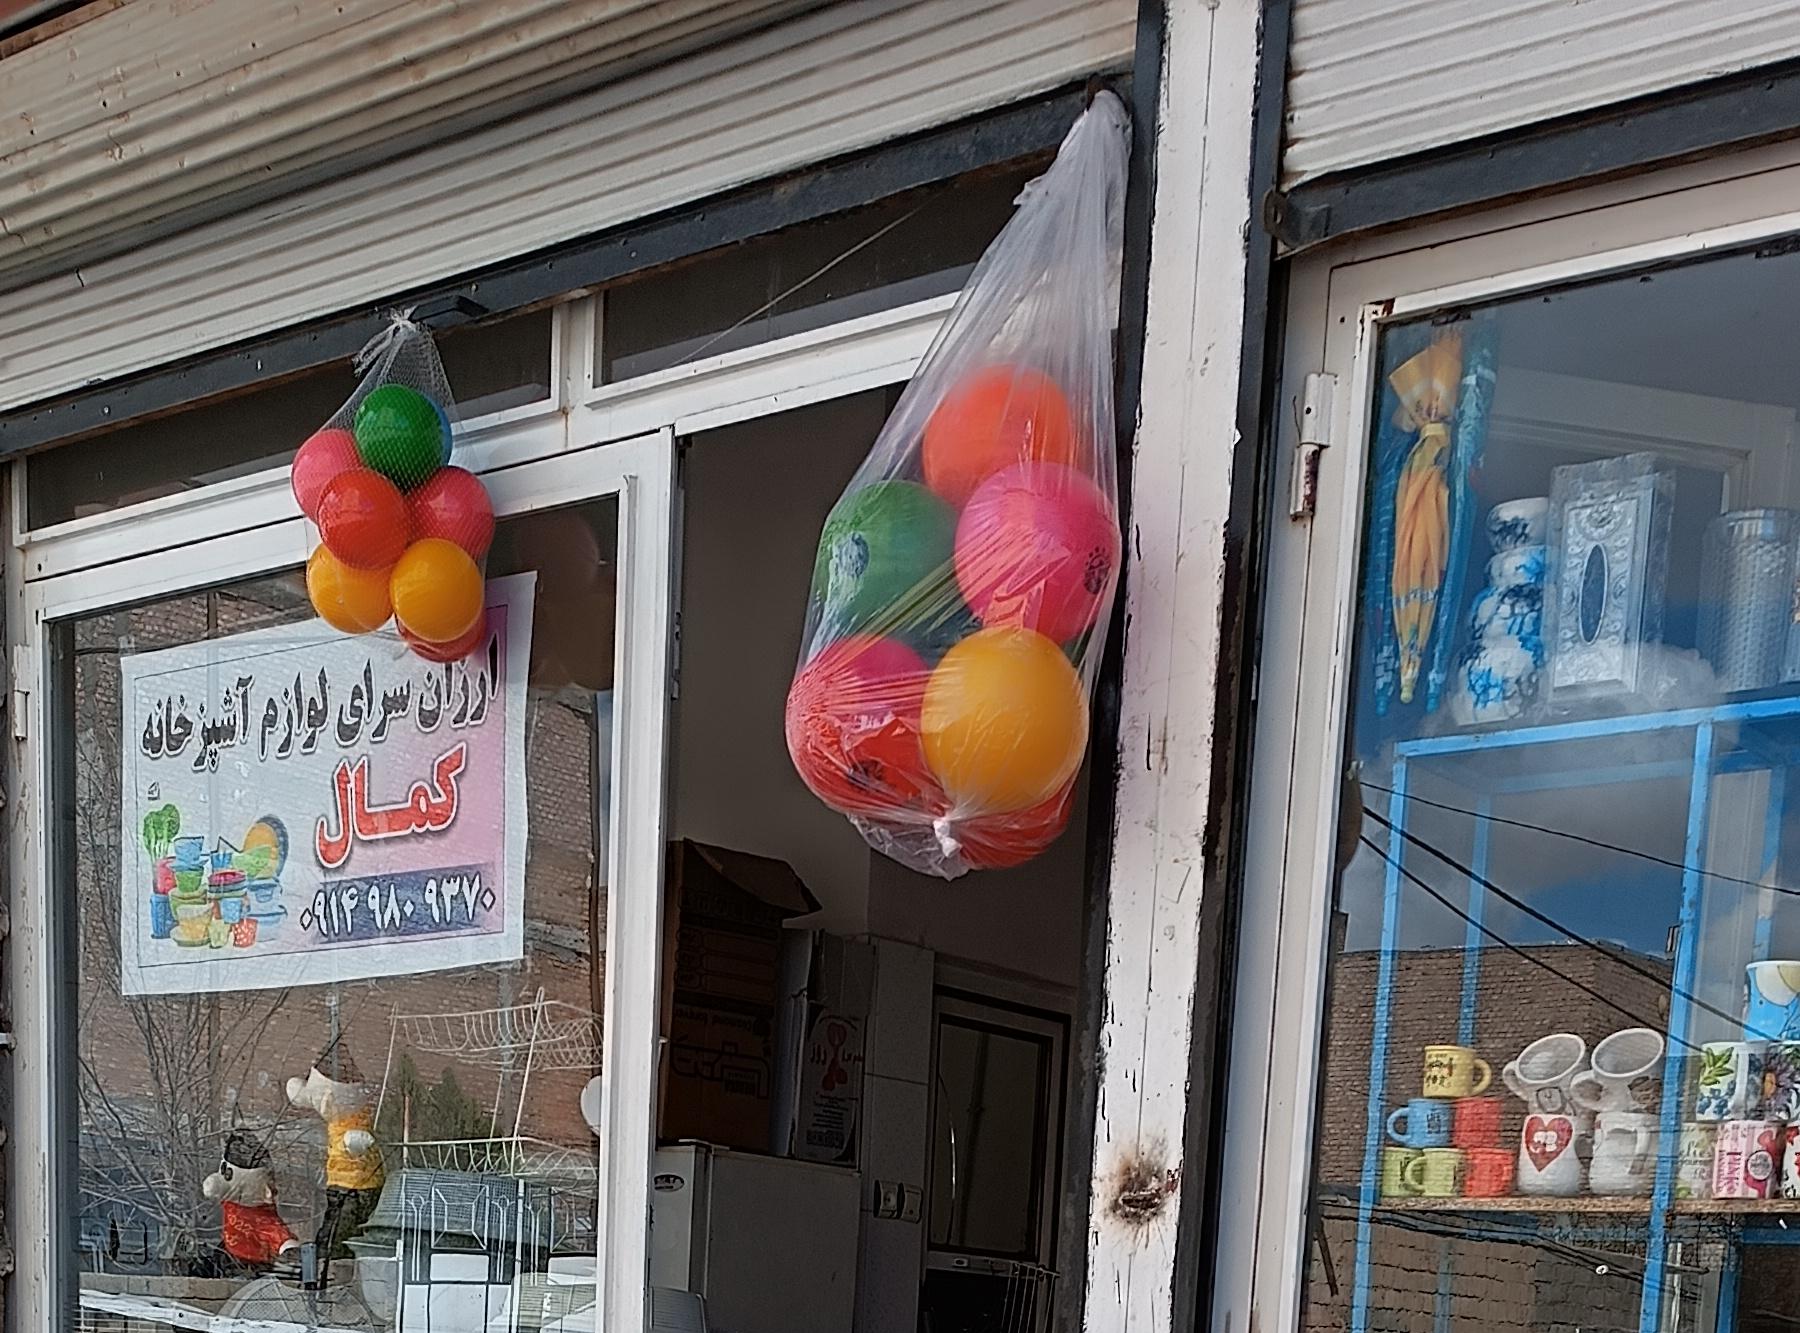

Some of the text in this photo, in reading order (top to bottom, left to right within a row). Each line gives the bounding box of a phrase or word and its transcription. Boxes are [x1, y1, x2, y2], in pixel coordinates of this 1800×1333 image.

[259, 665, 330, 761] لوازم
[335, 660, 413, 743] سرای
[416, 634, 500, 731] ارزان
[316, 741, 467, 868] کمال
[300, 872, 497, 936] ۰۹۱۴ ۹۸۰ ۹۳۷۰
